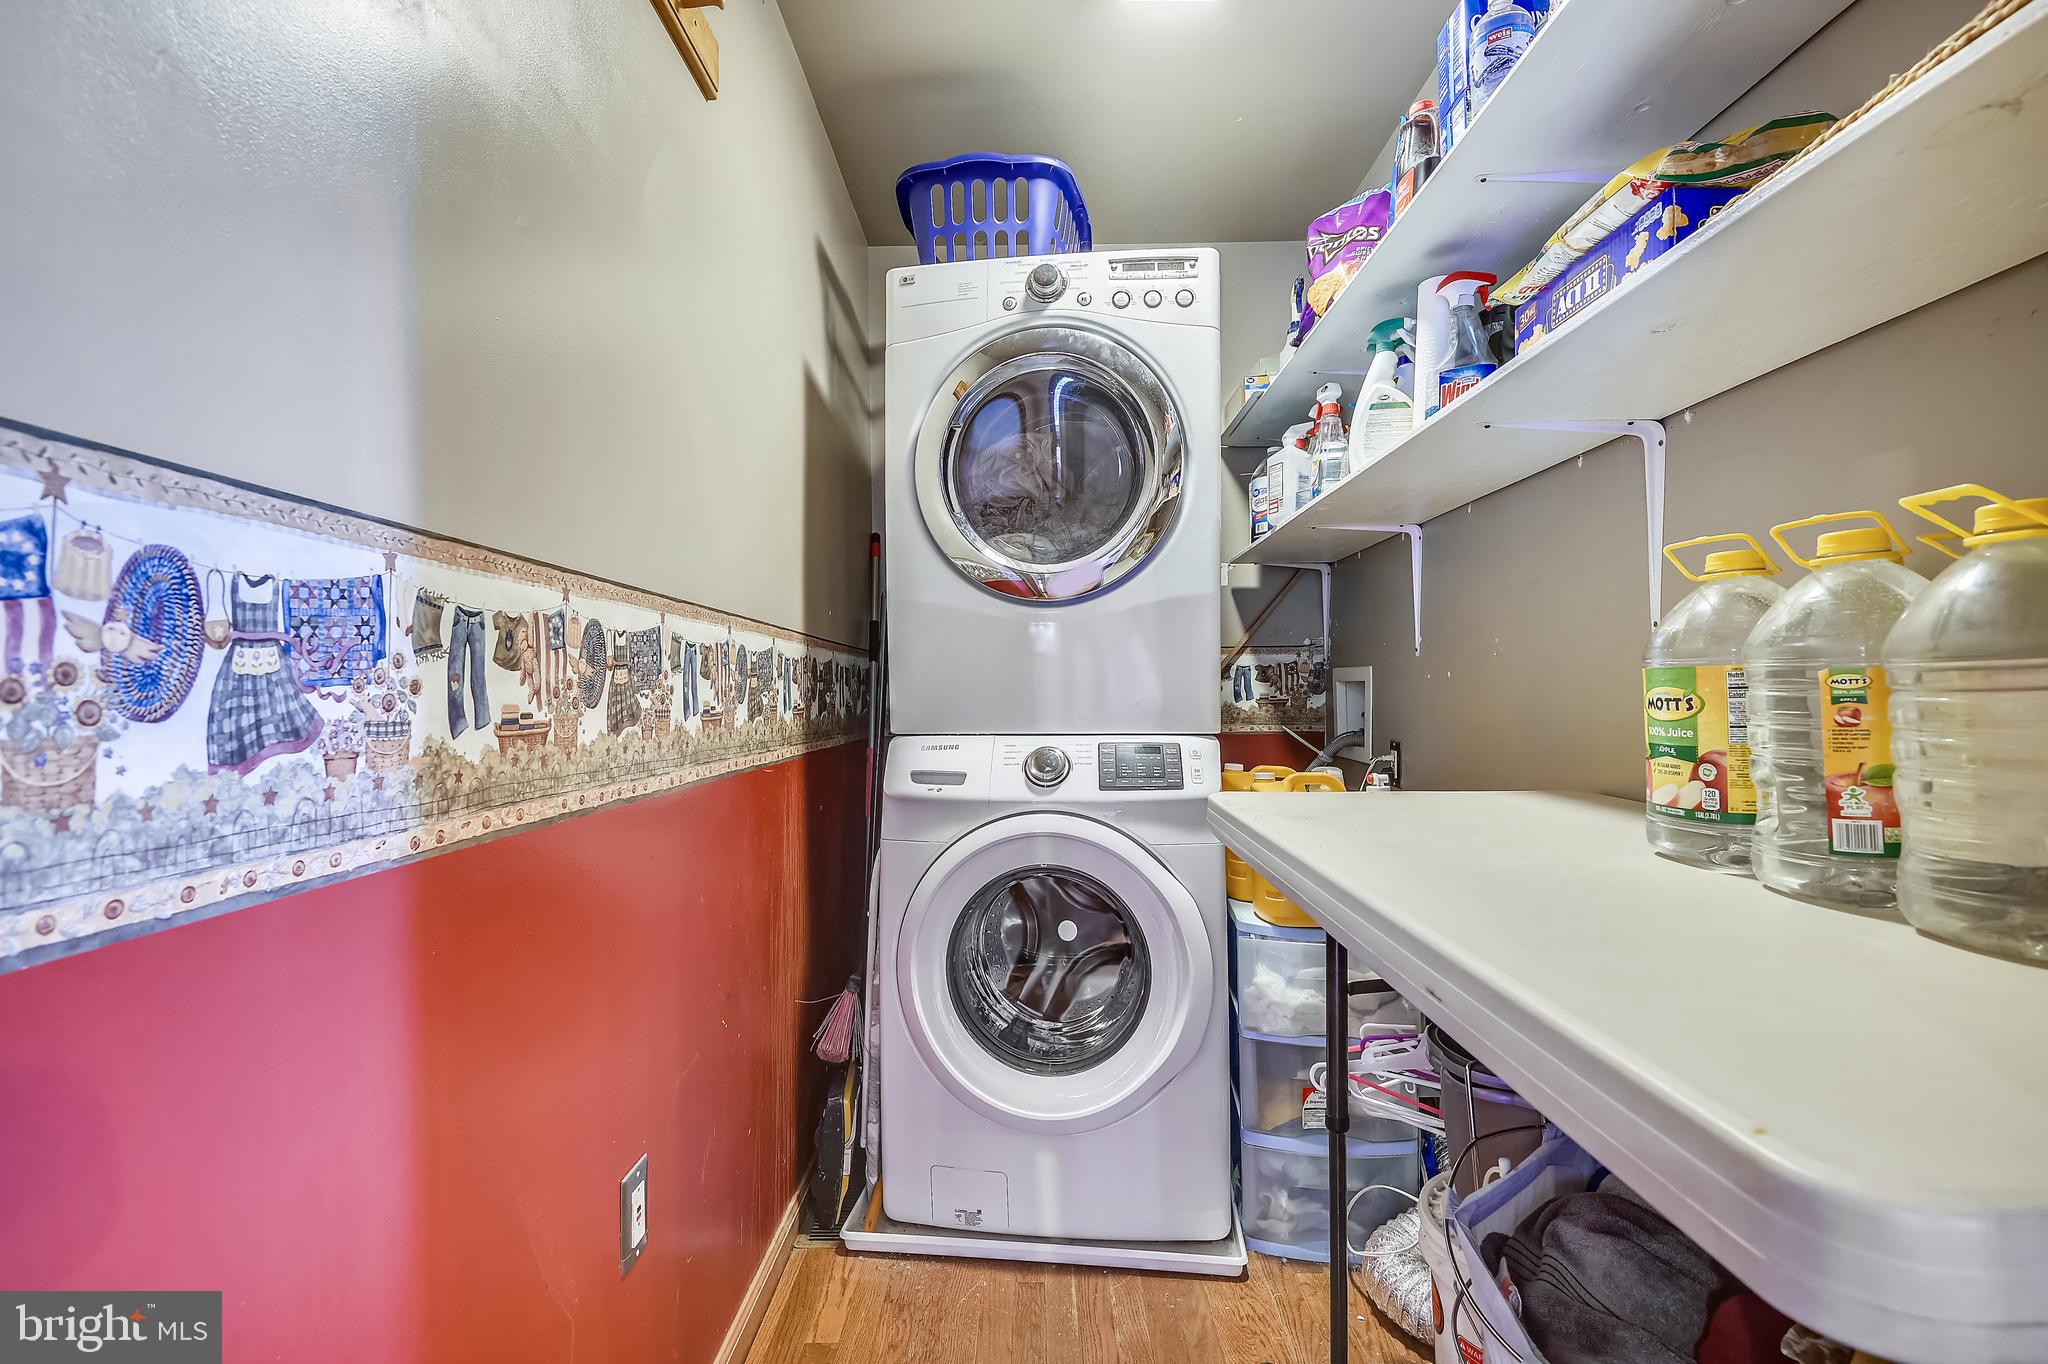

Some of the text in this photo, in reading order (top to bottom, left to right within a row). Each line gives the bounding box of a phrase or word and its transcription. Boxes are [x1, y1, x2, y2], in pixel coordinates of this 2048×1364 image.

[1489, 28, 1511, 41] weis
[1556, 287, 1583, 319] ACT
[1519, 309, 1530, 328] 30
[1441, 377, 1481, 409] Win
[1647, 697, 1694, 711] MOTT'S
[1648, 727, 1694, 738] 100% Juice
[1704, 790, 1716, 798] 120
